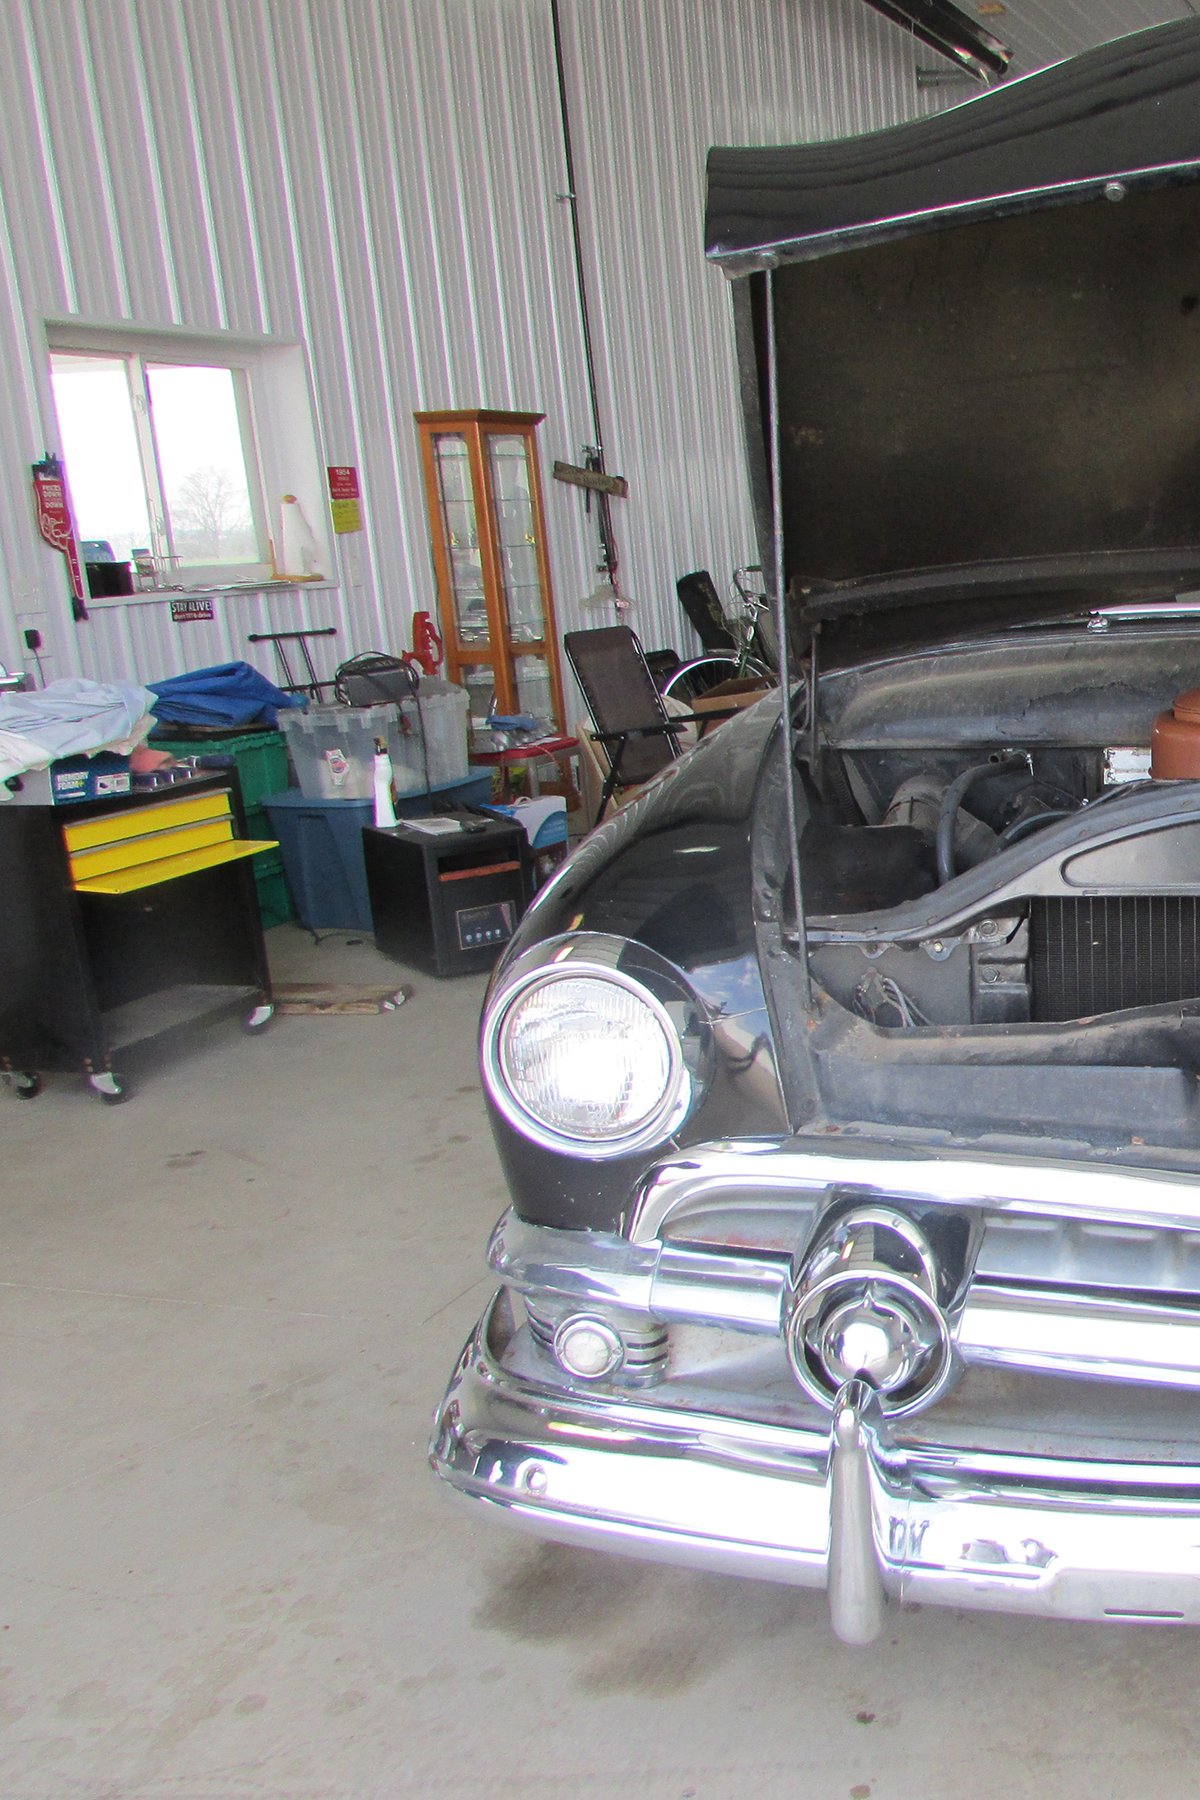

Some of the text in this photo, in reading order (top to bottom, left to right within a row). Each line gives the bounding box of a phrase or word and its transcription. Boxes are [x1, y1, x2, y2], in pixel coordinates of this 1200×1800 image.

[45, 501, 64, 509] DOWN
[171, 600, 213, 613] STAY ALIVE!
[57, 771, 89, 783] MEMORY
